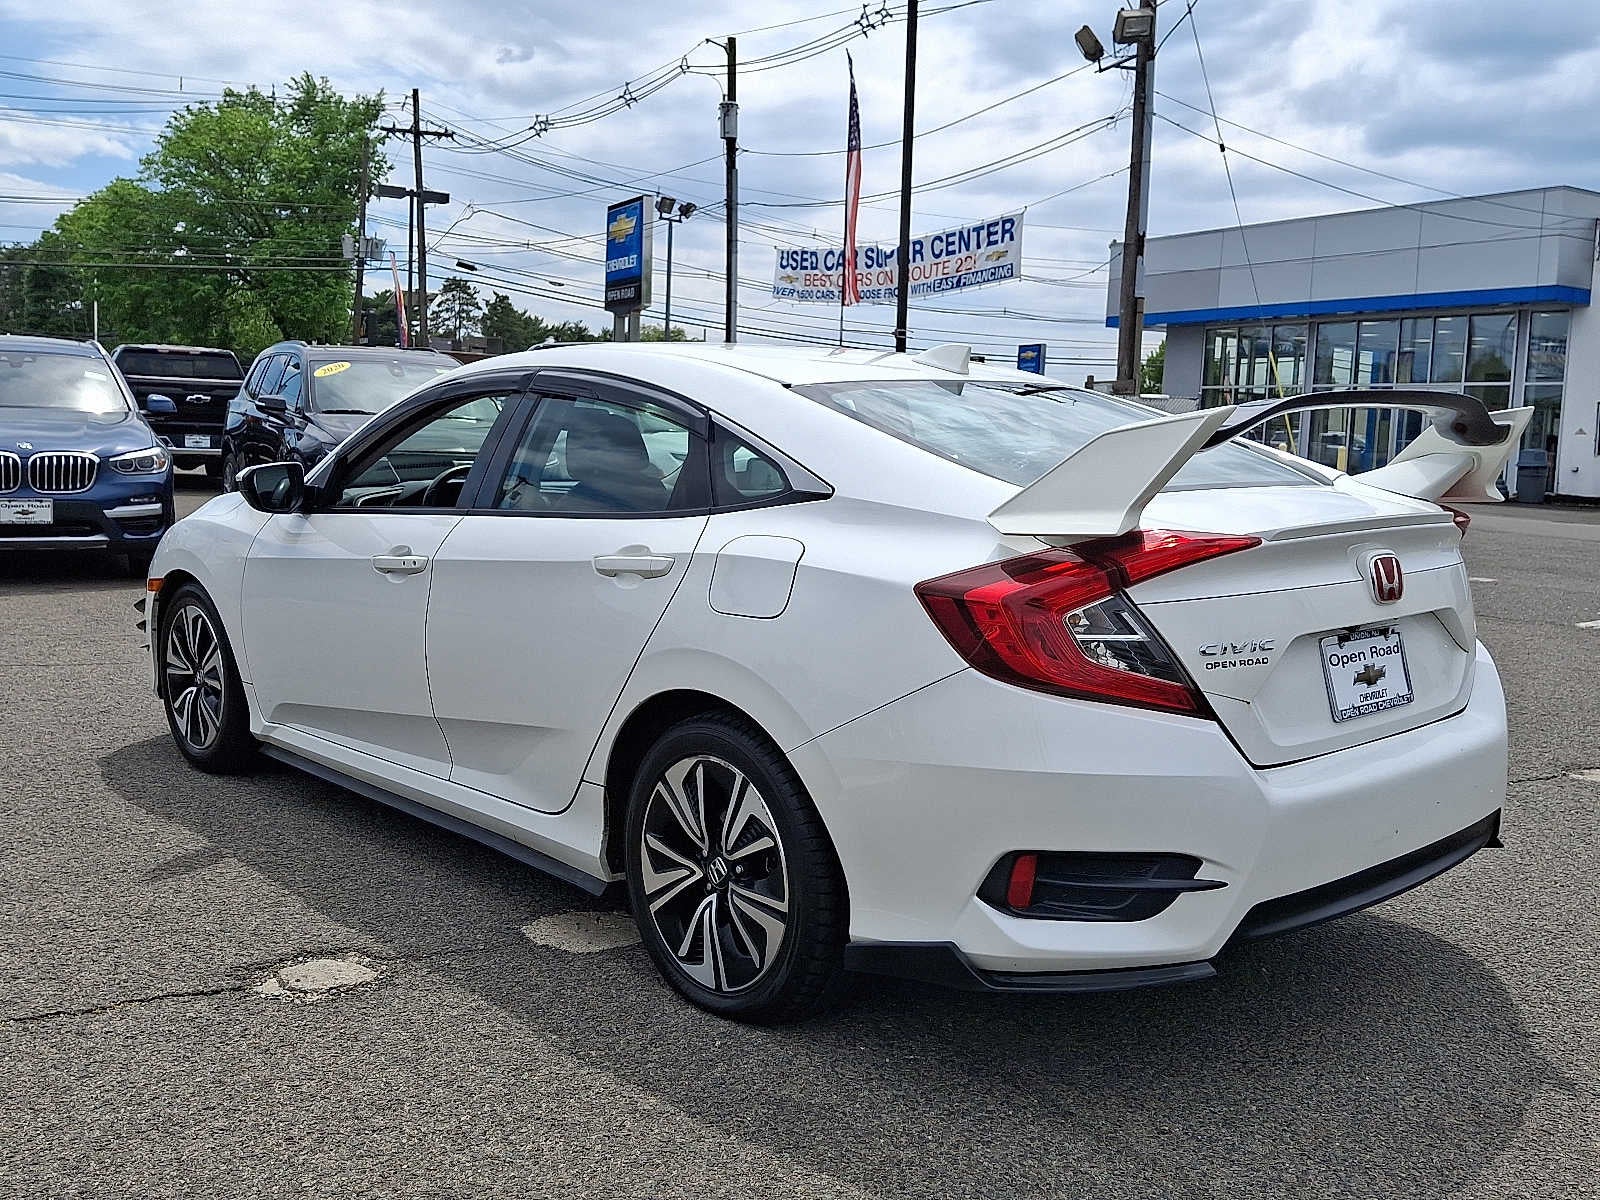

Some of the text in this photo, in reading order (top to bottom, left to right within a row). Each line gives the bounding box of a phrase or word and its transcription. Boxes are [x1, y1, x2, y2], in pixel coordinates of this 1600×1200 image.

[780, 217, 1015, 272] USED CA SUPR CENTER
[804, 273, 834, 288] BEST
[836, 272, 872, 288] CRS
[876, 269, 894, 286] ON
[908, 259, 951, 282] OUTE
[883, 286, 899, 299] FRO
[910, 281, 933, 295] WITH
[934, 275, 959, 292] EASY
[960, 264, 1013, 286] FINANCING
[1199, 639, 1275, 656] CIVIC
[1328, 641, 1400, 669] Open Road
[1205, 656, 1269, 670] OPEN ROAD
[1341, 693, 1413, 719] OPEN ROAD CHEVROLET
[1359, 688, 1388, 703] CHEVROLET
